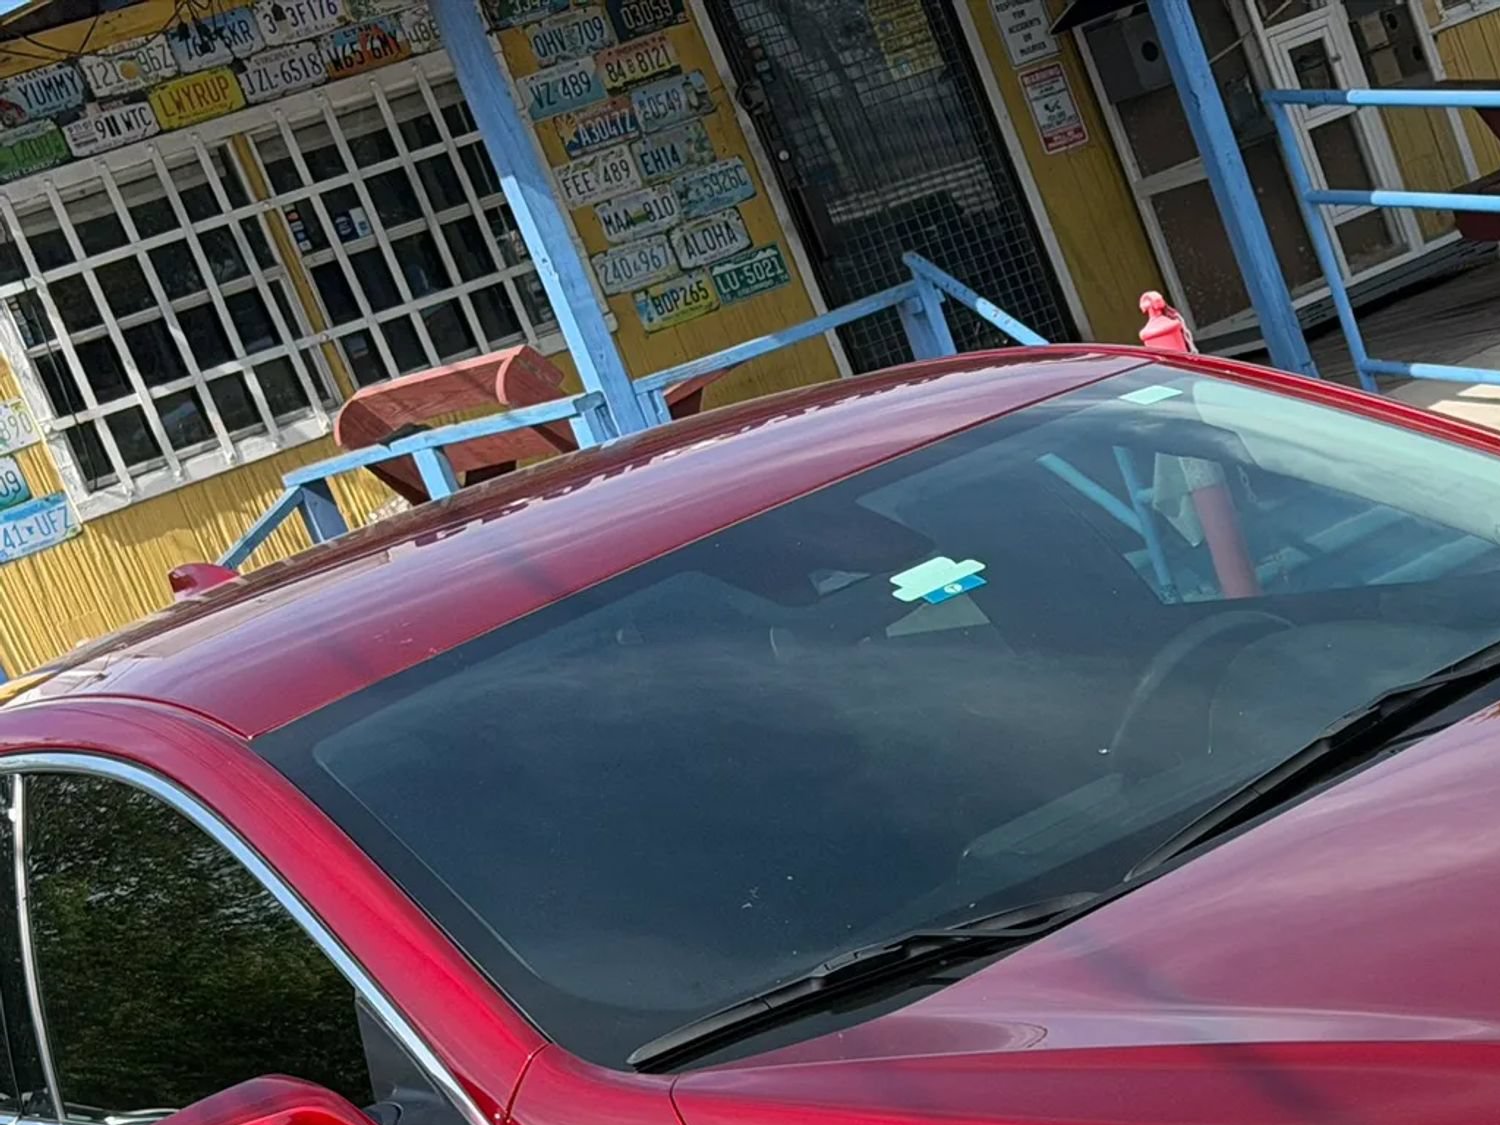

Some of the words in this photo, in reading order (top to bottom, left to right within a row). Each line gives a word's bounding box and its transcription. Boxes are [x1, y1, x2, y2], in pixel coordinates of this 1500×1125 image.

[576, 16, 606, 45] 709
[18, 70, 79, 109] YUMMY
[157, 75, 230, 118] LWYRUP
[561, 70, 591, 100] 489
[120, 107, 152, 133] WTC
[561, 170, 595, 199] FEE
[603, 158, 631, 186] 489
[602, 209, 637, 237] MAA
[685, 219, 739, 260] ALOHA
[600, 257, 633, 287] 240
